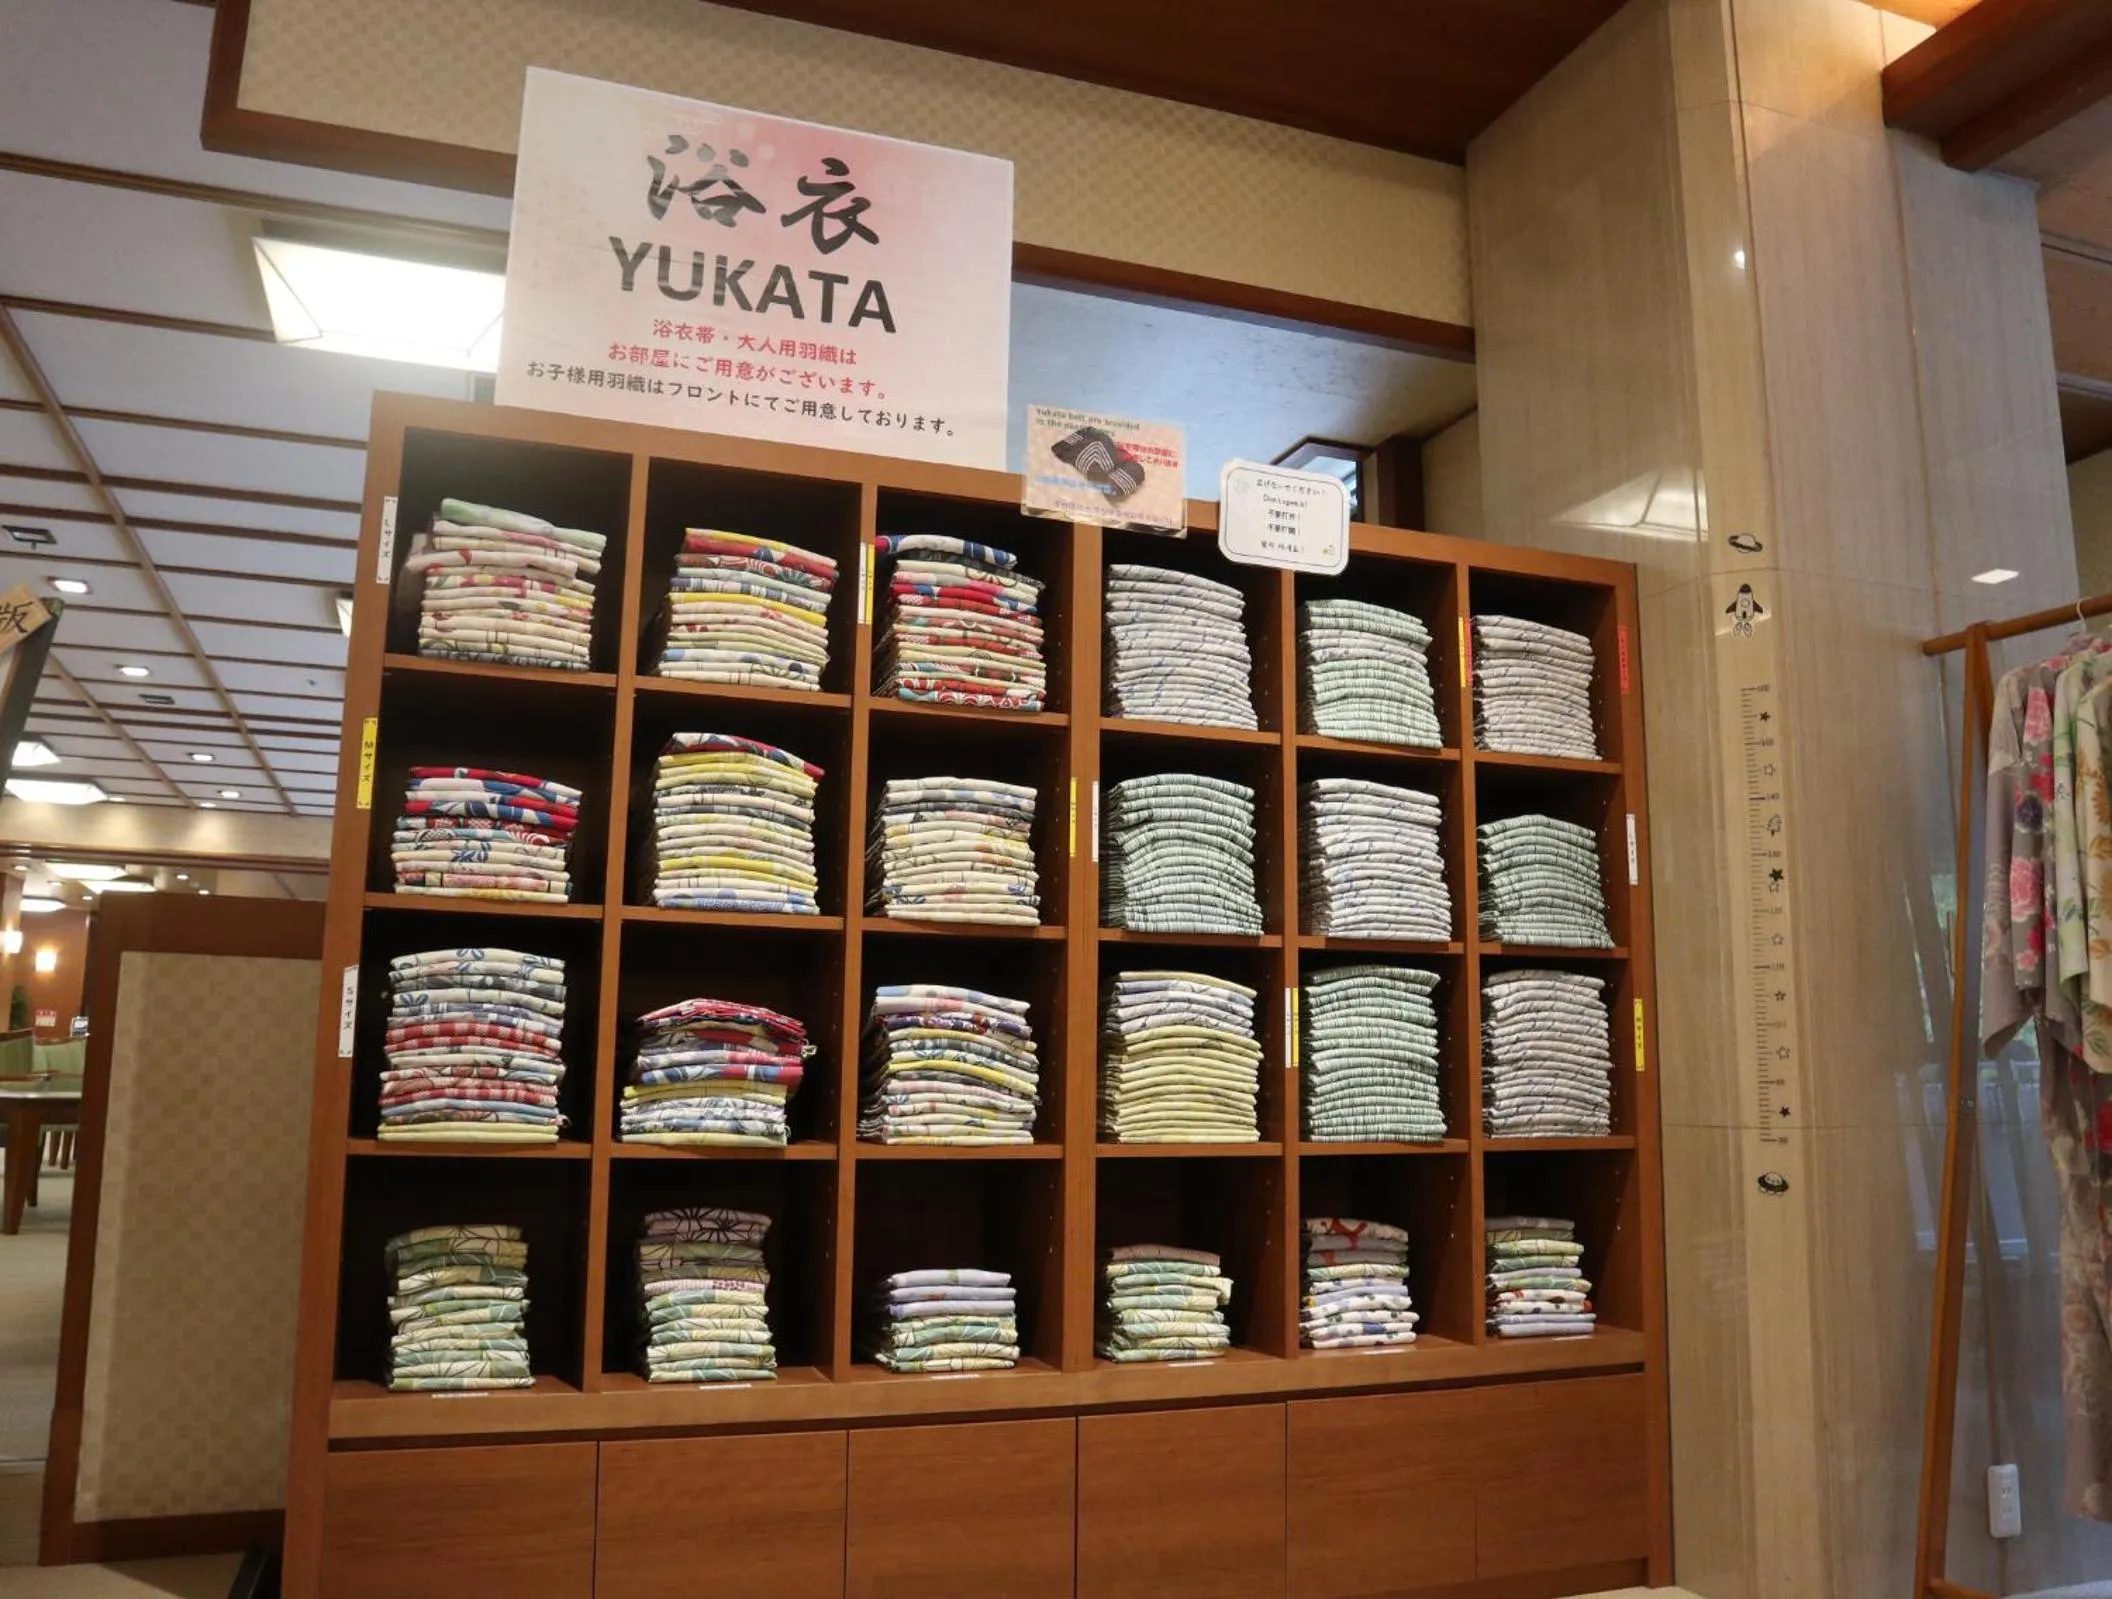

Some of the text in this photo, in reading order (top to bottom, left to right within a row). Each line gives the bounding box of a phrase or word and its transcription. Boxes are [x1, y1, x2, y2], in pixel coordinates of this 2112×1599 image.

[647, 134, 880, 255] 浴衣
[608, 235, 897, 334] YUKATA
[608, 341, 886, 400] お部屋にご用意がございます。
[652, 318, 857, 365] 浴衣帯・大人用羽織は
[526, 360, 954, 438] お子様用羽織はフロントにてご用意しております。
